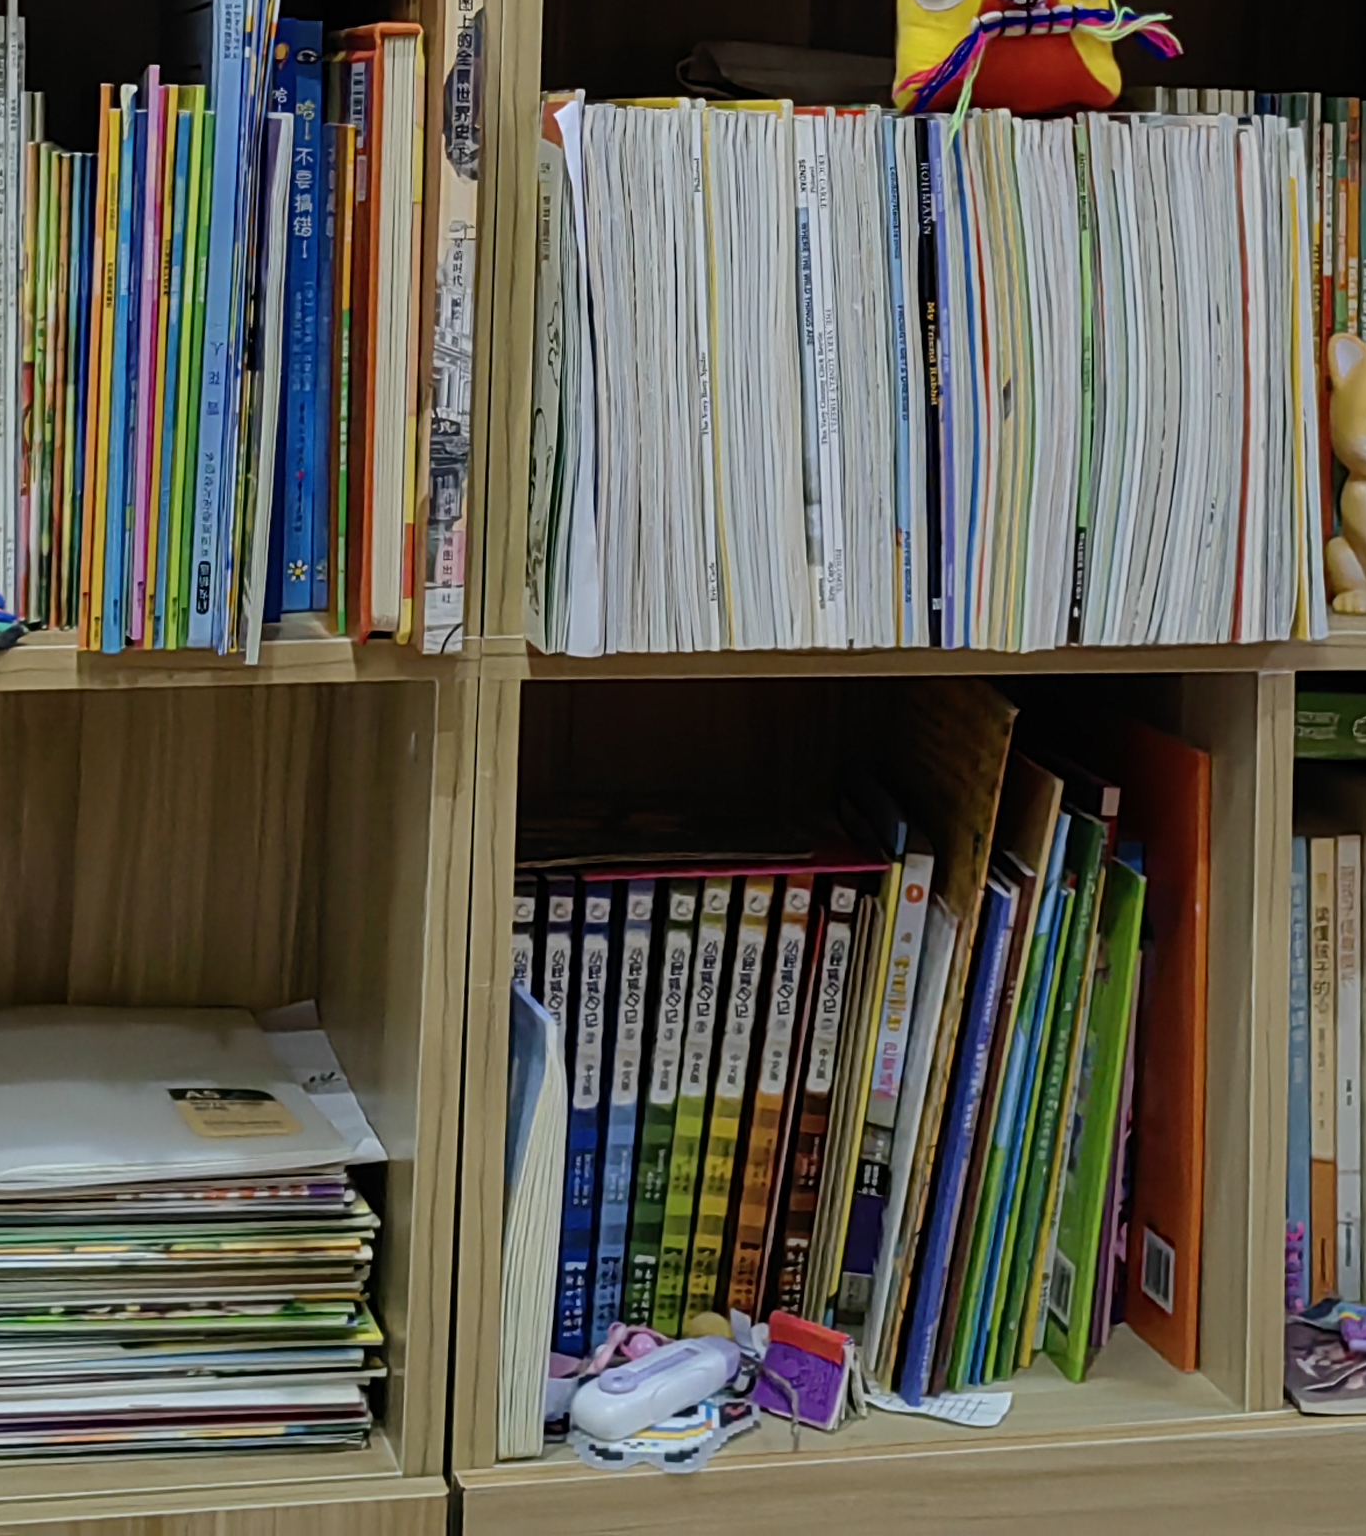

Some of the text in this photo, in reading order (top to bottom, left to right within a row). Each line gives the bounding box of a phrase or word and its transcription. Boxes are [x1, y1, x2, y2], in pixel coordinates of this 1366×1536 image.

[798, 159, 806, 193] SENDAK
[819, 177, 827, 209] CARLE
[920, 162, 932, 235] ROHMANN
[802, 222, 810, 252] WHERE
[804, 273, 812, 294] WILD
[805, 297, 813, 326] THINGS
[927, 301, 938, 405] My Friend Rabbit
